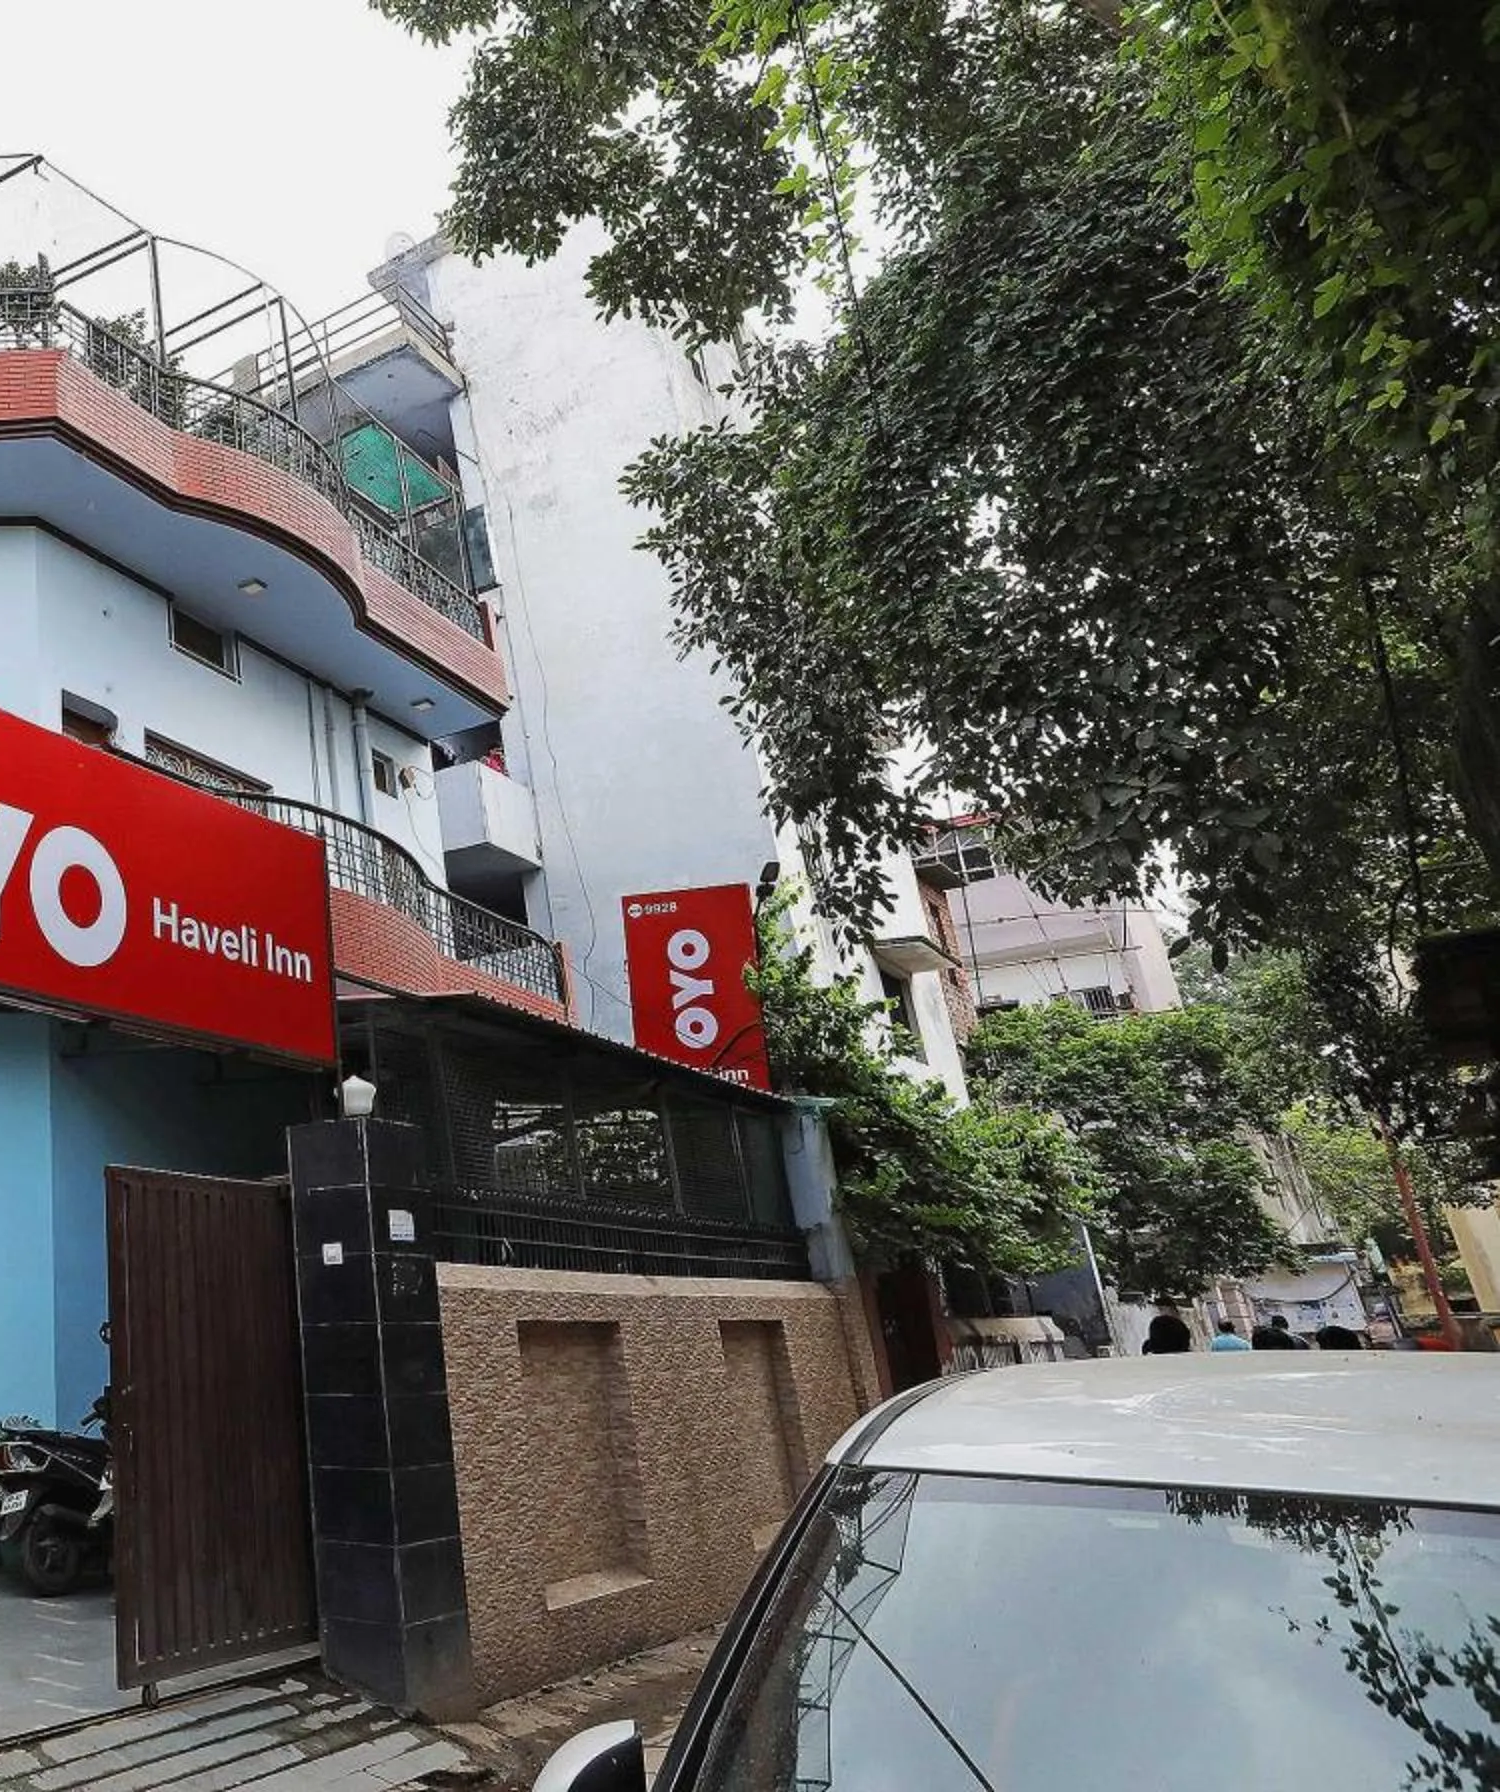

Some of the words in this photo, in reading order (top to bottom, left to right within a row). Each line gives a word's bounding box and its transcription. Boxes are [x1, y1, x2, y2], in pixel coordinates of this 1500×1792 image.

[153, 897, 258, 967] Haveli
[265, 933, 313, 983] Inn
[667, 929, 719, 1049] OYO
